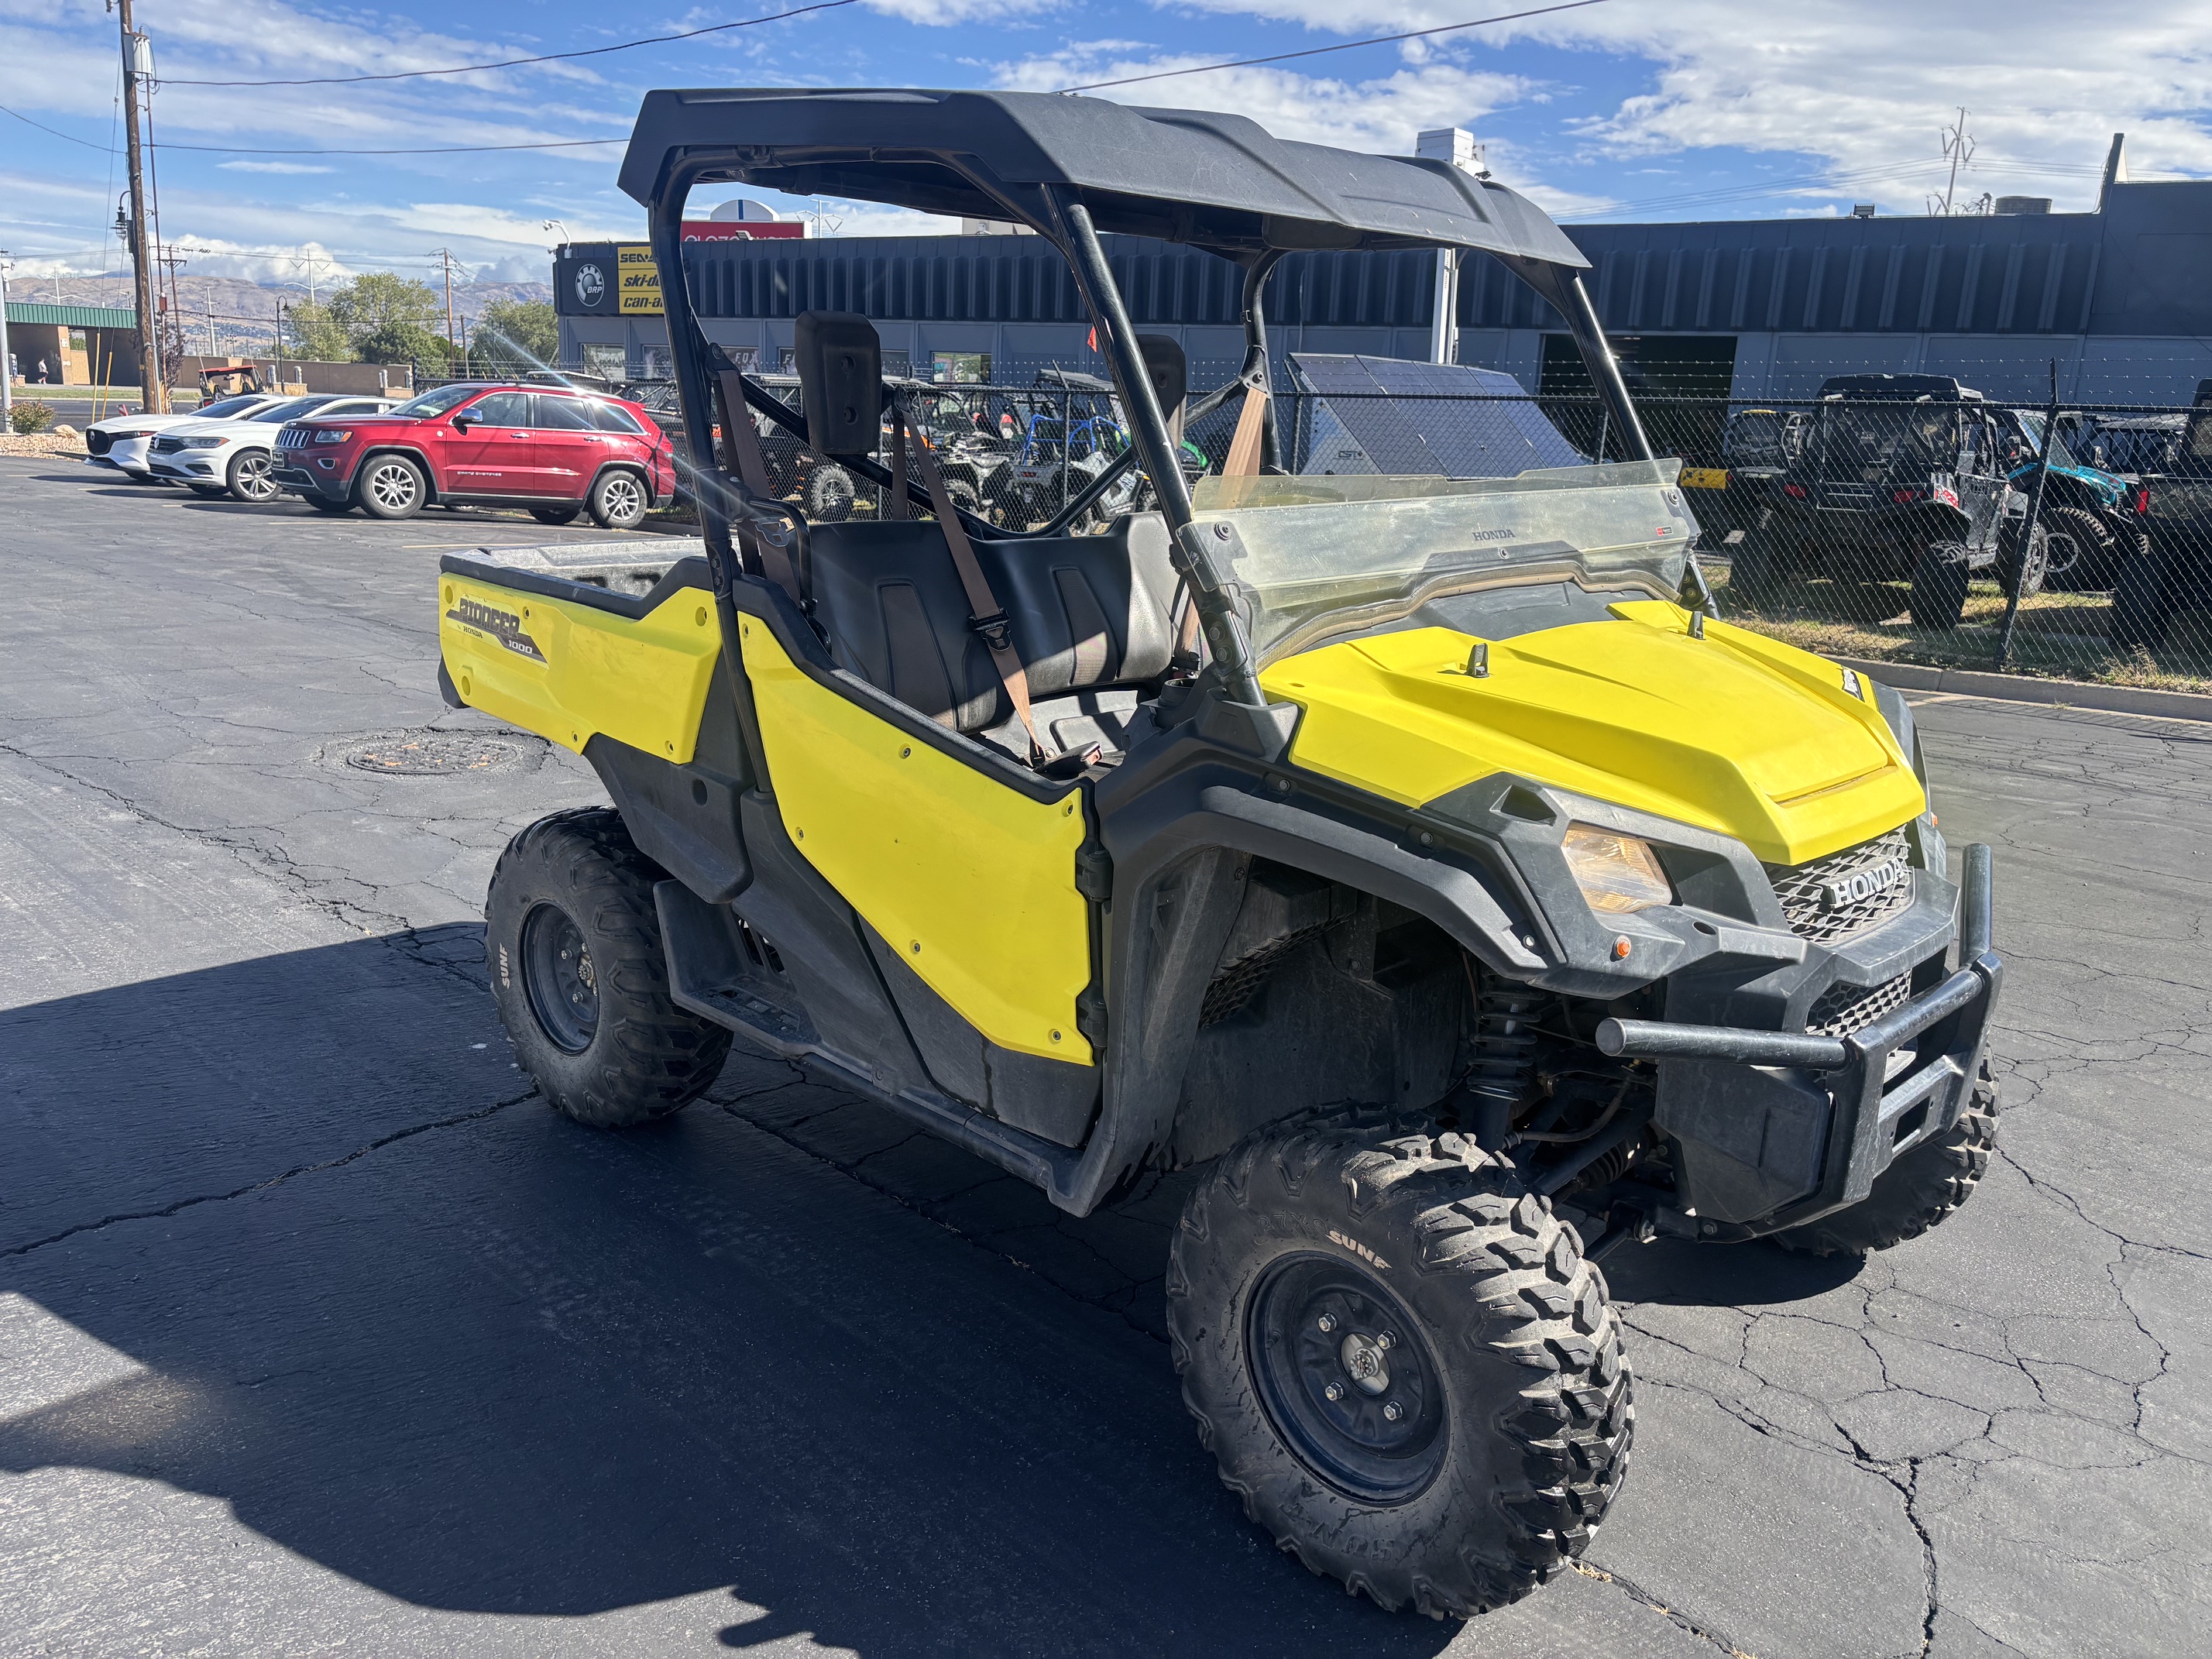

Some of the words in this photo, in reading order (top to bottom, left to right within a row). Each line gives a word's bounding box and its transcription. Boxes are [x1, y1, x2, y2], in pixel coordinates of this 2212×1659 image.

[1472, 529, 1516, 541] HONDA
[459, 597, 520, 639] PIONEER
[463, 626, 483, 638] HONDA
[508, 639, 533, 654] 1000
[1829, 857, 1910, 908] HONDA
[500, 943, 510, 990] SUNF
[1325, 1230, 1393, 1269] SUNF
